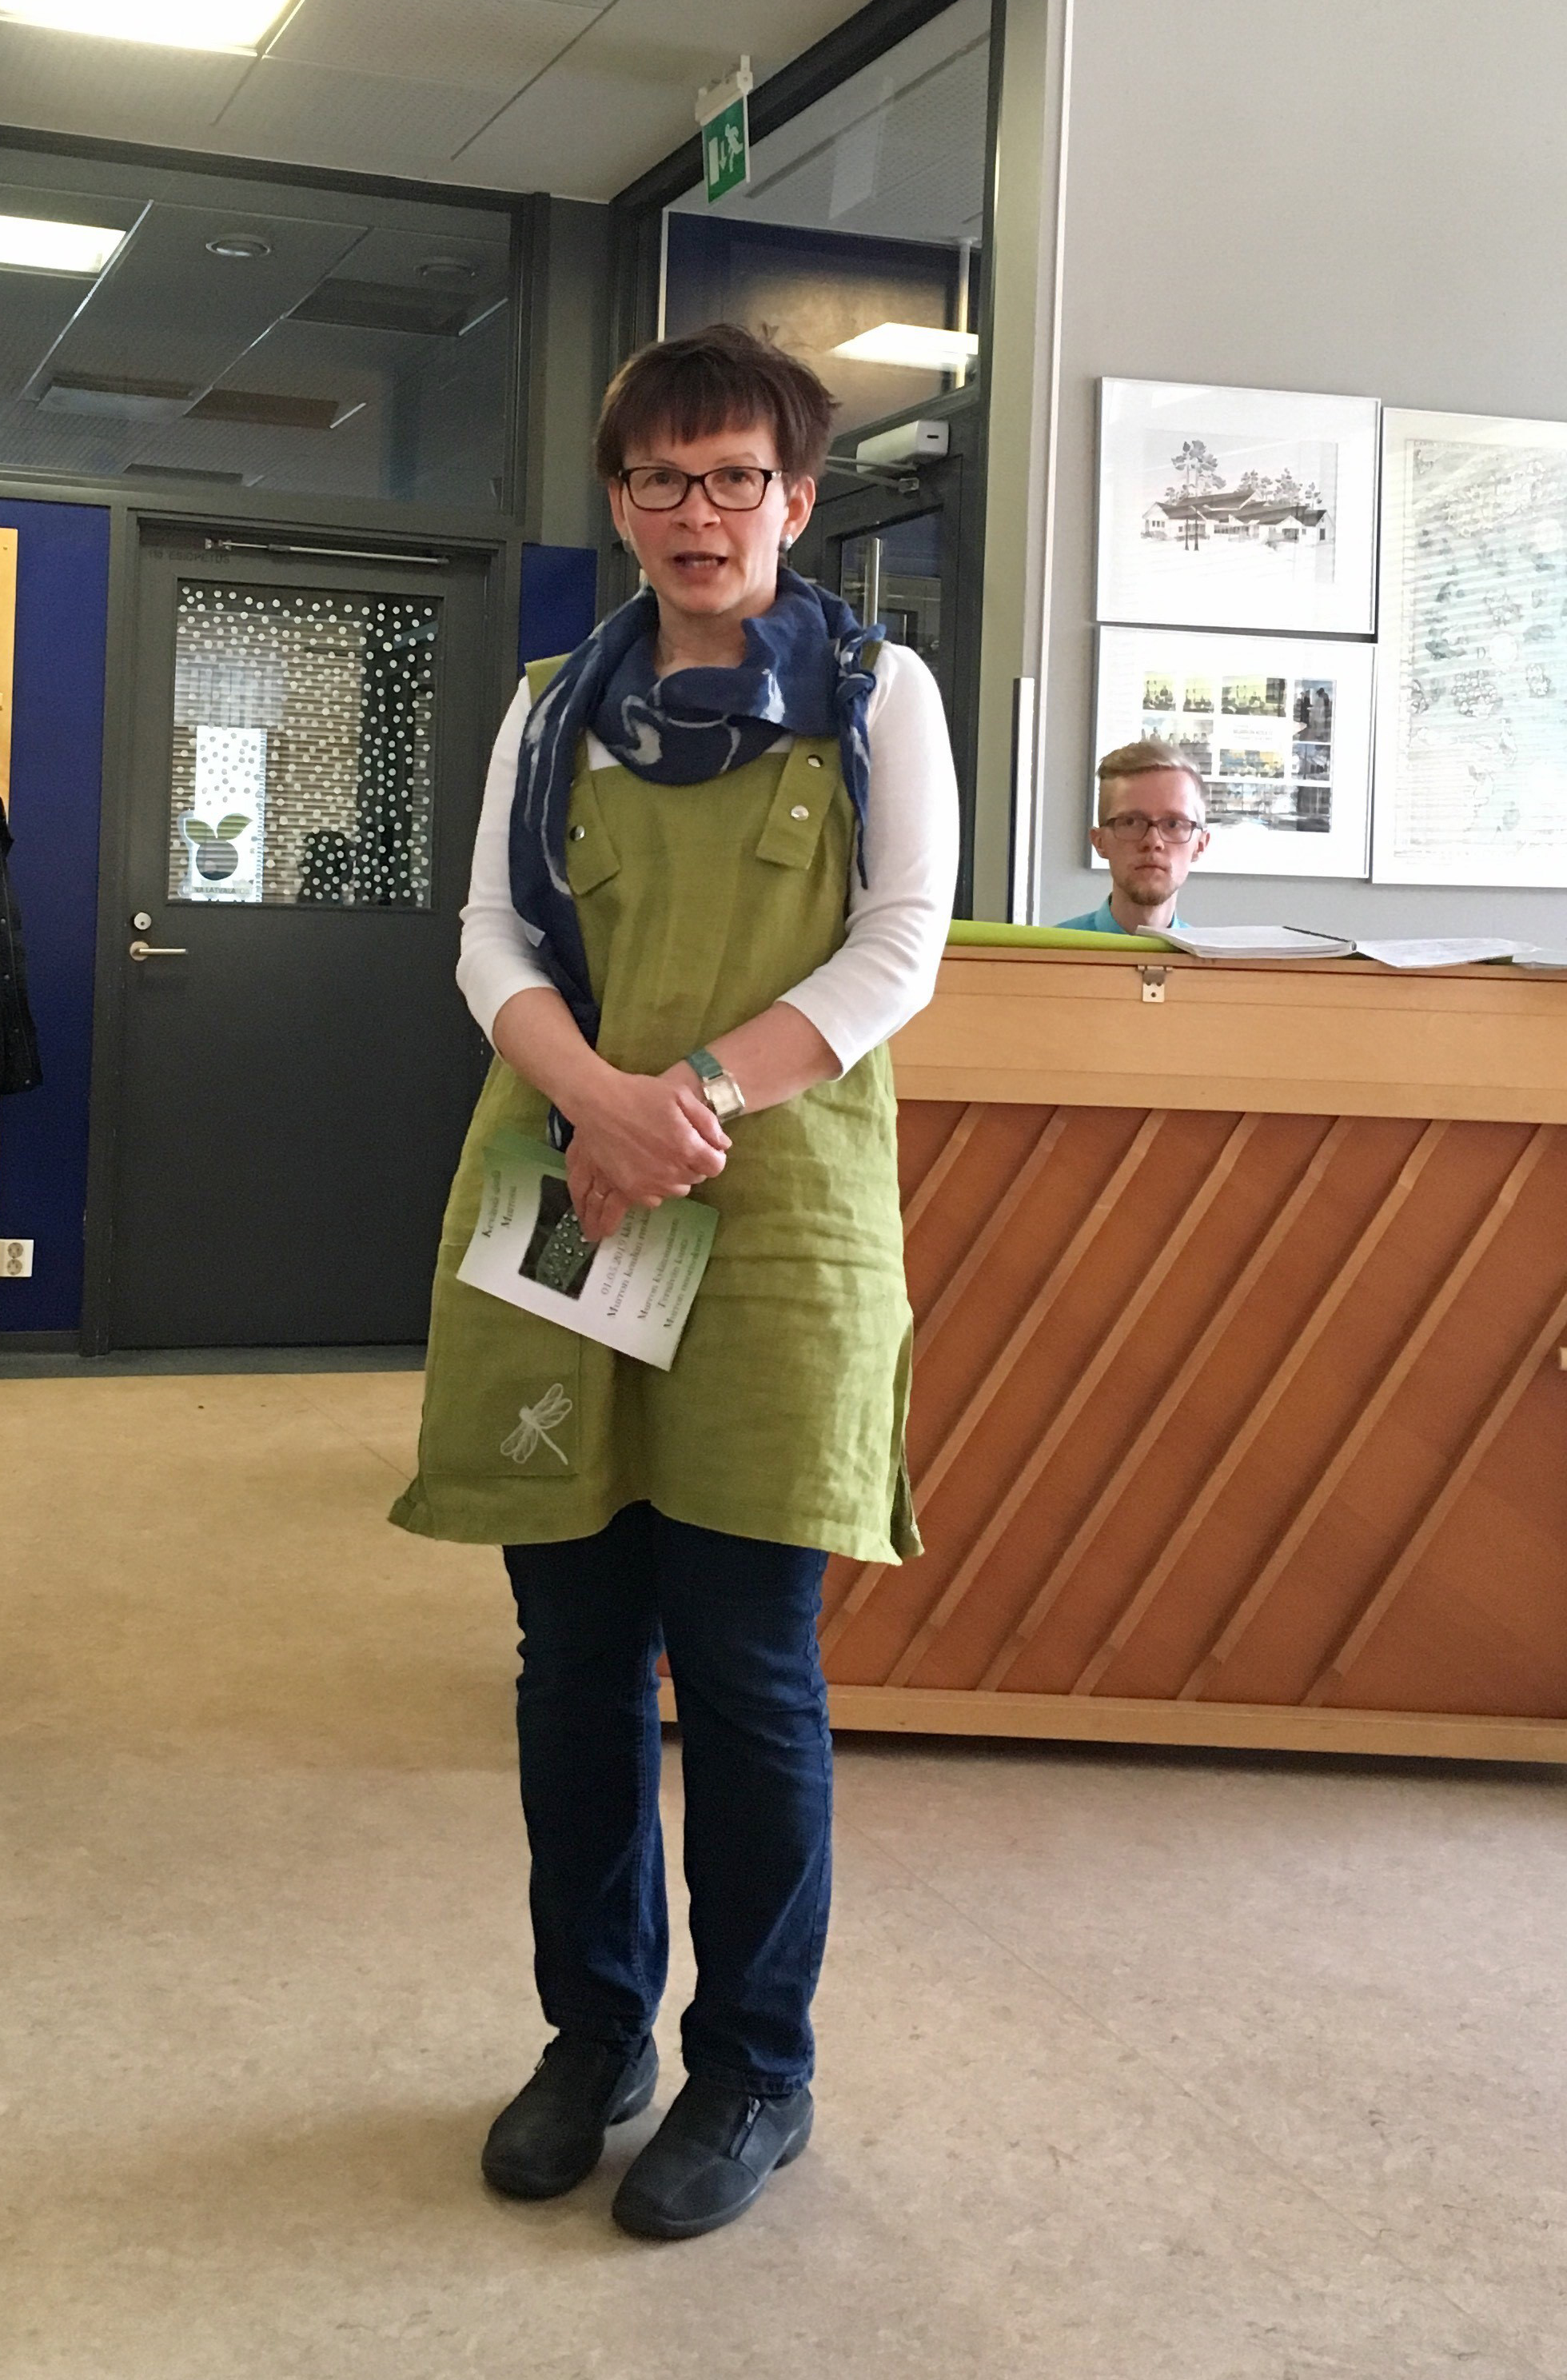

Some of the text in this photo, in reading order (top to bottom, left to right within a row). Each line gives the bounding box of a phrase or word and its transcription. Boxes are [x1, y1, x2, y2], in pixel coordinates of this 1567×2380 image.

[607, 1280, 630, 1319] Murron
[637, 1284, 658, 1320] Murron
[664, 1293, 685, 1329] Murron
